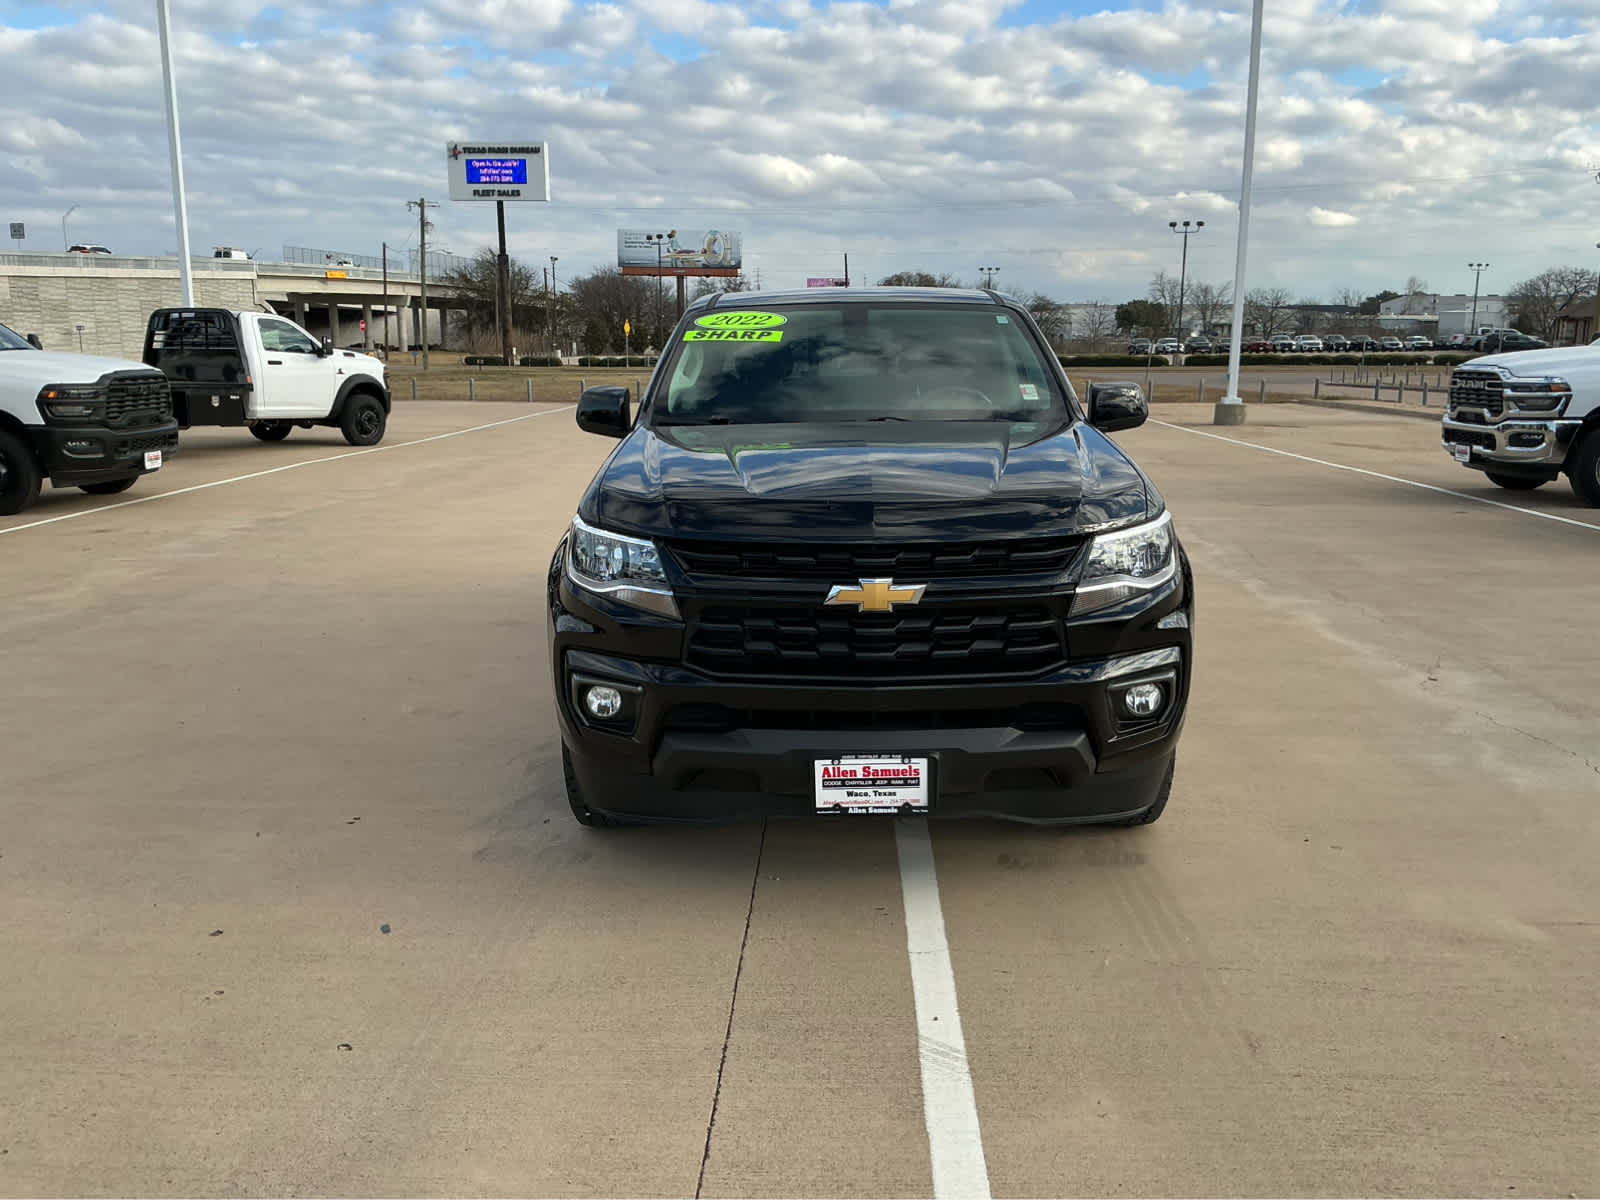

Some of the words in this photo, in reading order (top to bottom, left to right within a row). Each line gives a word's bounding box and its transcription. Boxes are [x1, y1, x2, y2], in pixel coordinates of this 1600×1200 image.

[710, 315, 772, 325] 2022
[693, 331, 772, 340] SHARP
[822, 766, 857, 778] Allen
[862, 765, 920, 777] Samuels
[868, 806, 898, 814] Samuels
